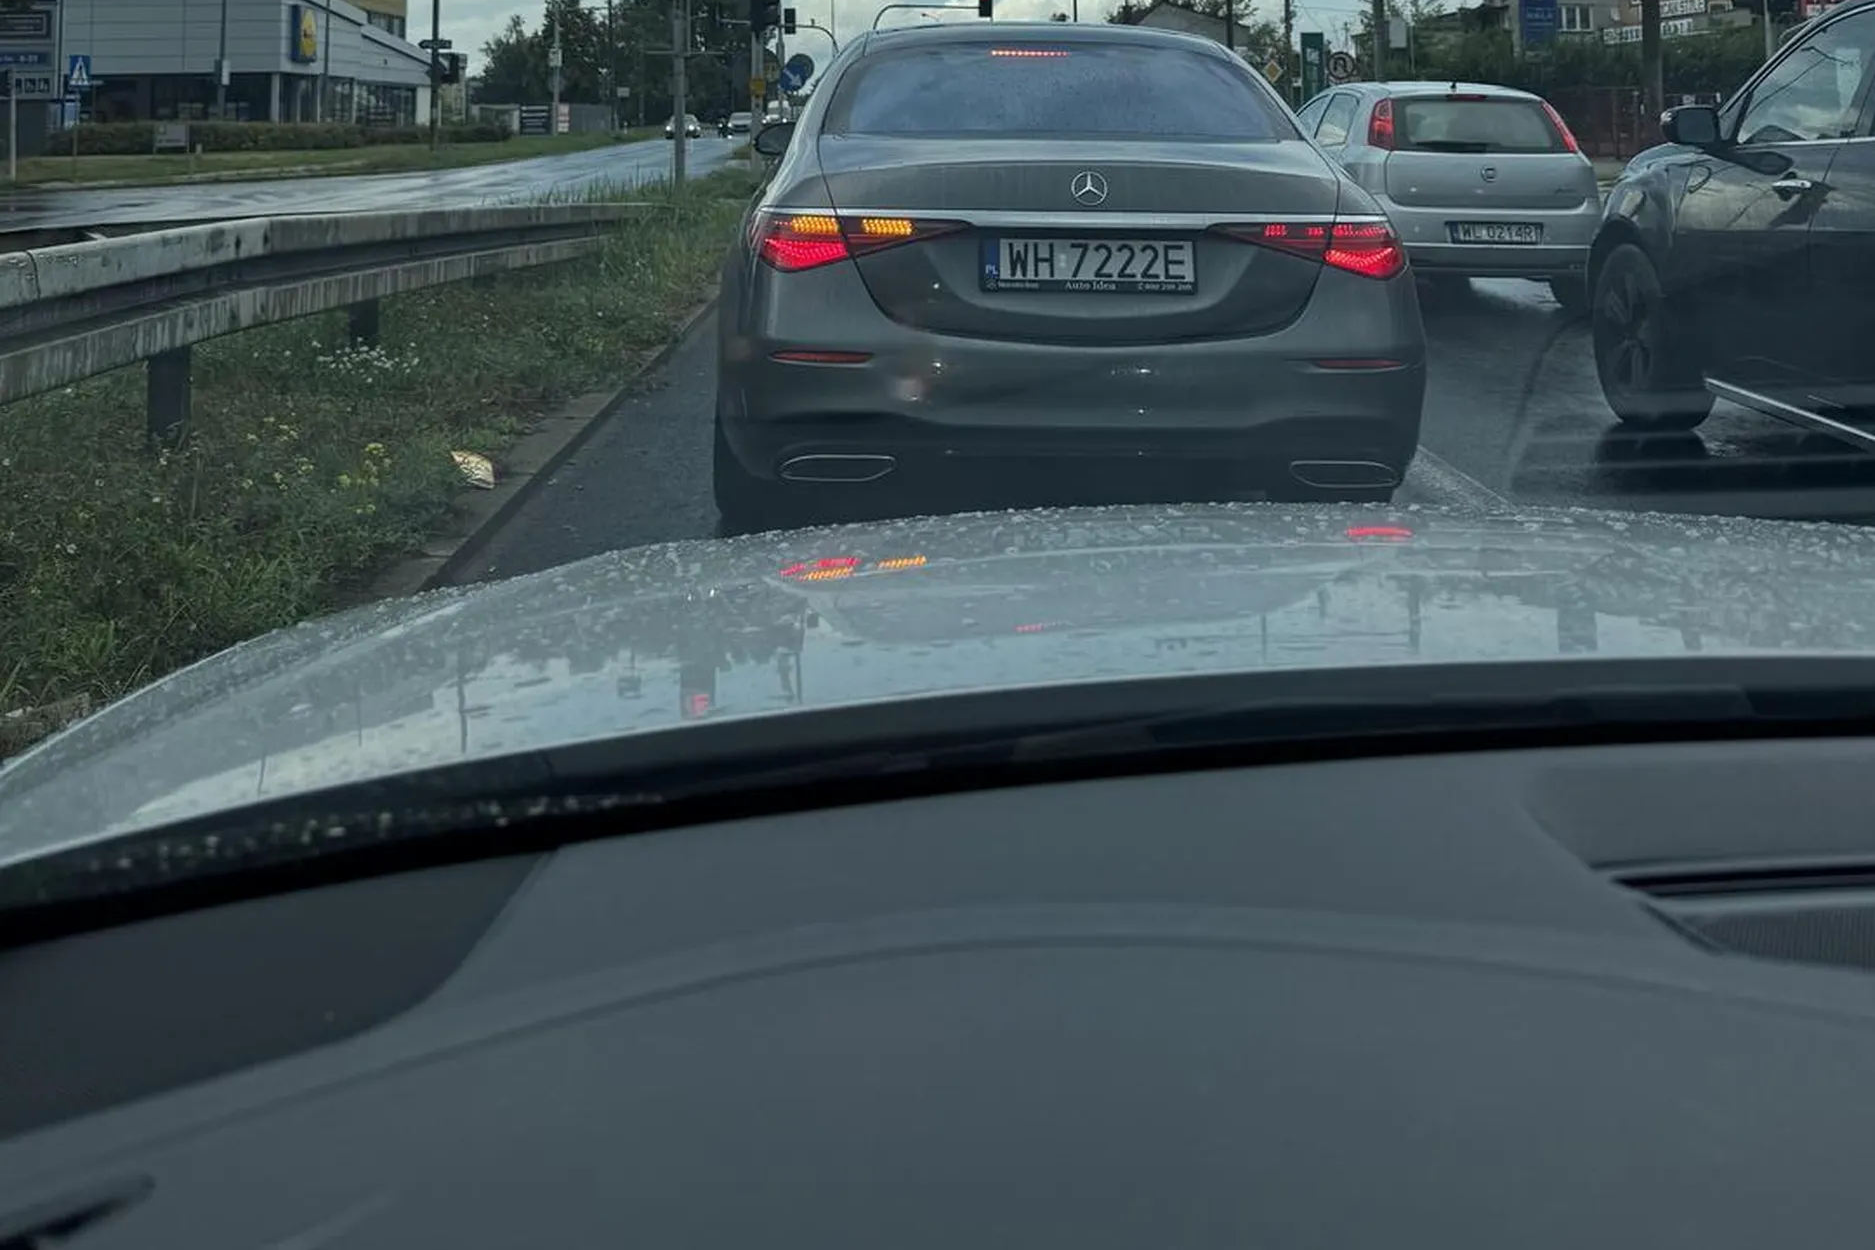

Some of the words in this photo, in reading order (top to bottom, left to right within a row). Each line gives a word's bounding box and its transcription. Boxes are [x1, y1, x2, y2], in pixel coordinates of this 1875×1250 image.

[1008, 241, 1055, 279] WH
[1070, 242, 1186, 281] 7222E
[1064, 280, 1091, 291] Auto
